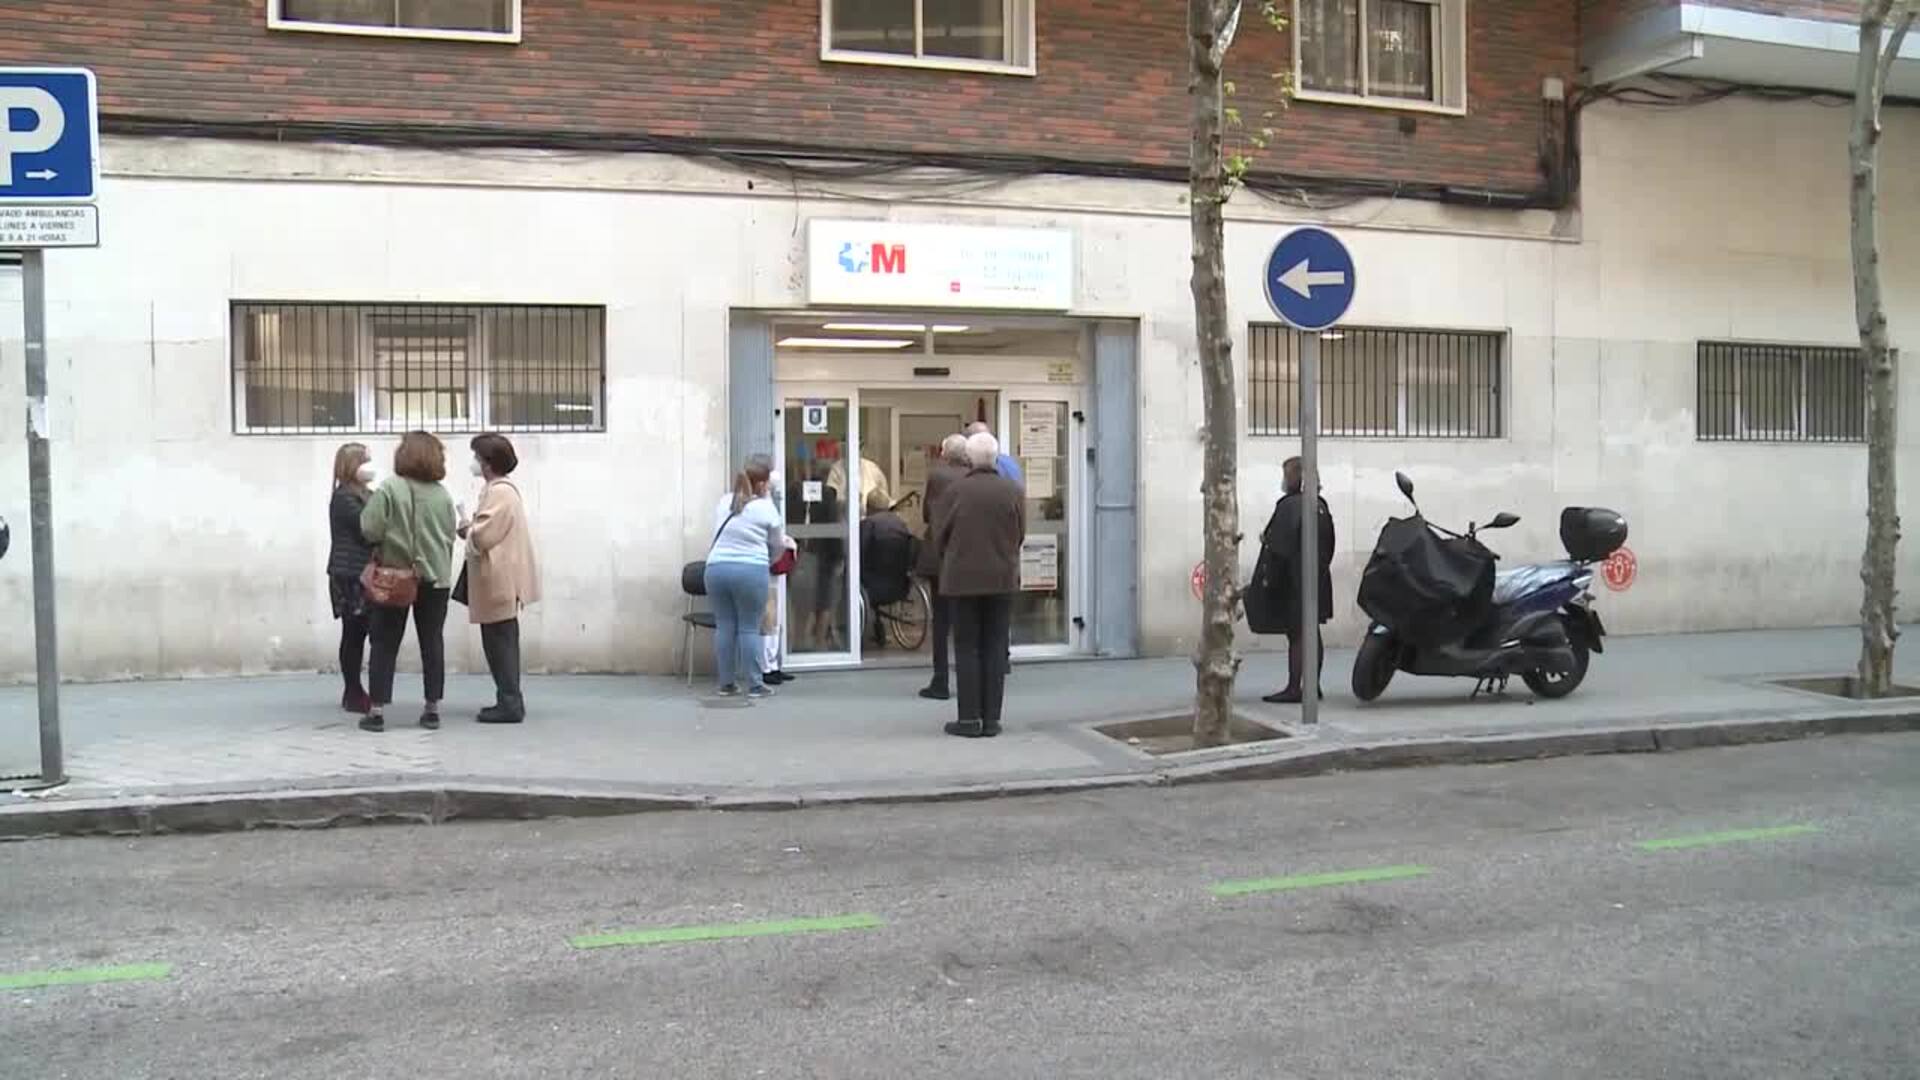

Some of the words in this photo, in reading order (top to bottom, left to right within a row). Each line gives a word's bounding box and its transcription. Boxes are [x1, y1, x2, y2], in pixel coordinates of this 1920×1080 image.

[0, 86, 65, 186] P
[25, 209, 85, 218] AMBULANCIAS
[39, 221, 75, 230] VIERNES
[38, 233, 67, 242] HORAS
[872, 243, 905, 273] M
